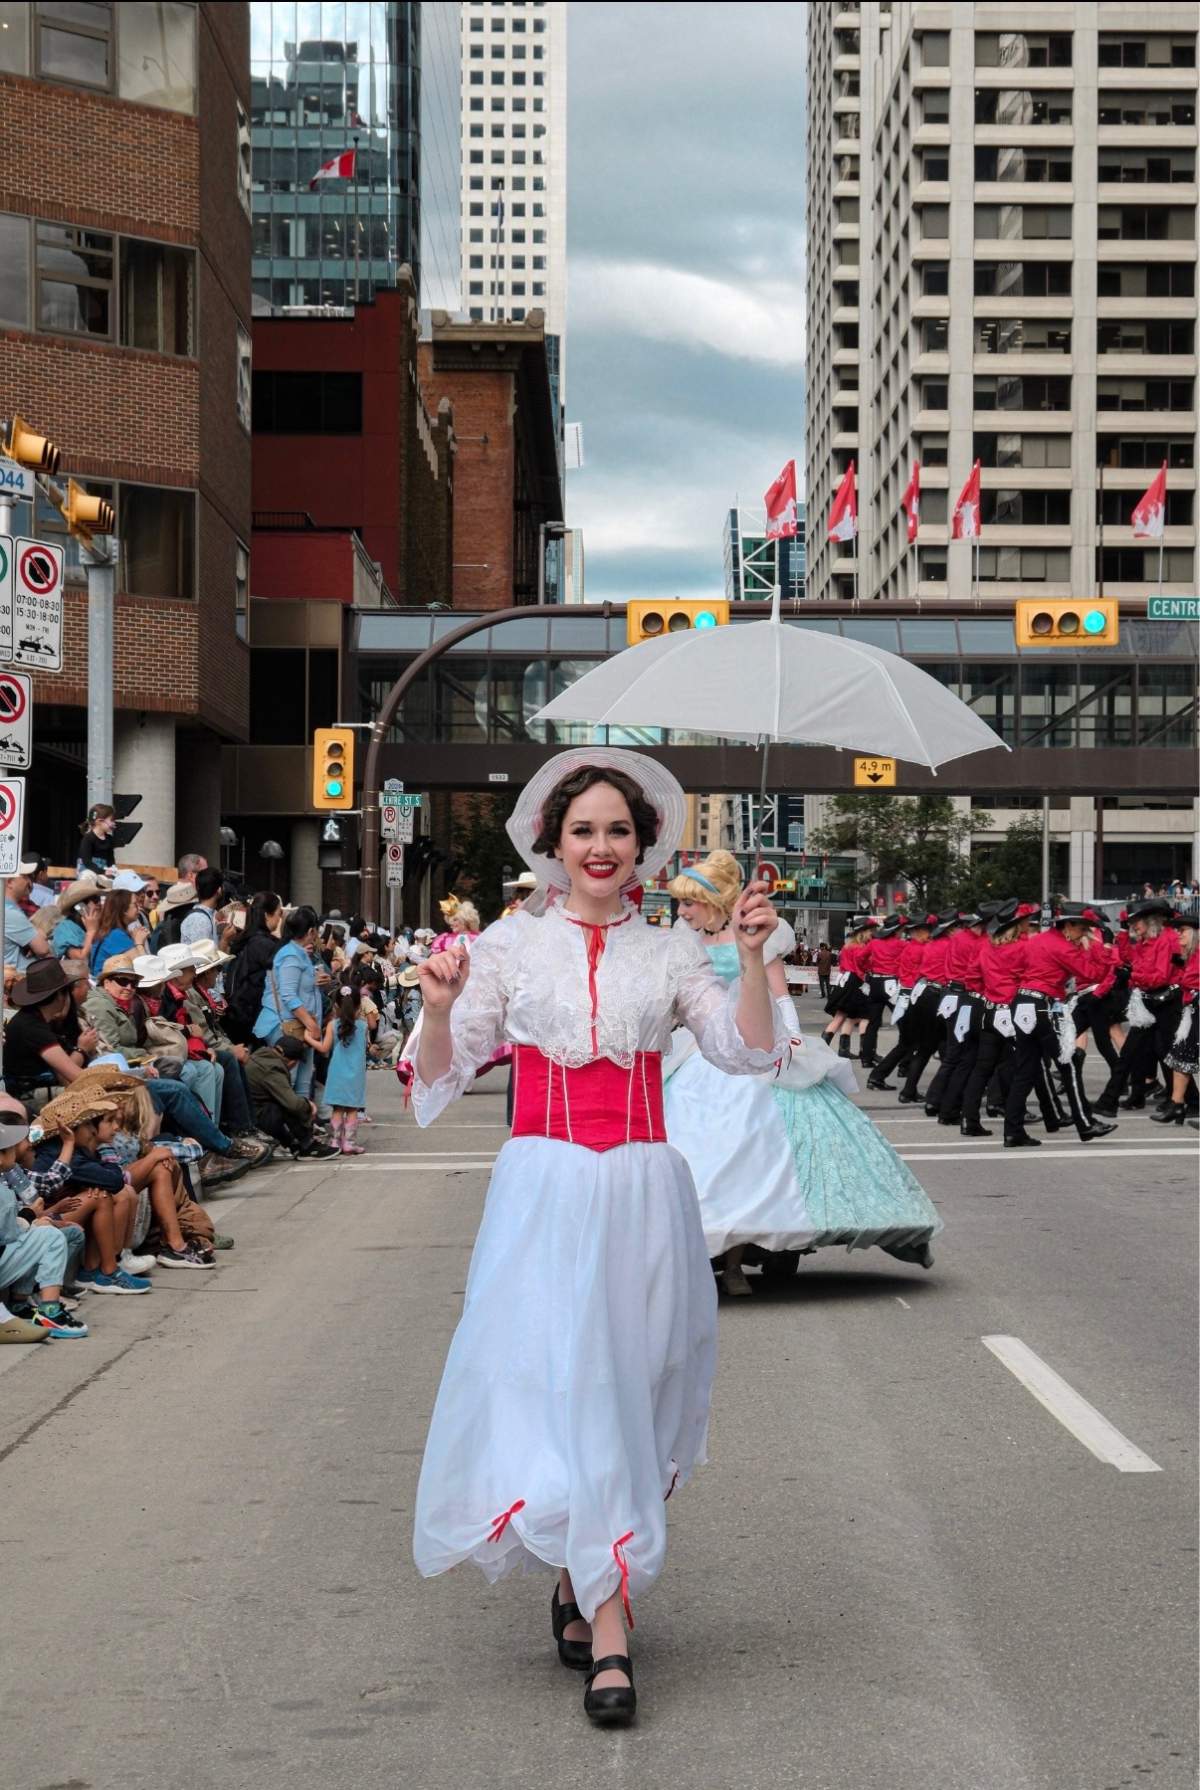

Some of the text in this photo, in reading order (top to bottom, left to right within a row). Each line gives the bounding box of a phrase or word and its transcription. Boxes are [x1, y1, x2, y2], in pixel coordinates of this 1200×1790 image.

[1153, 600, 1200, 616] CENTR
[859, 761, 891, 771] 4.9 m
[404, 795, 412, 805] ST
